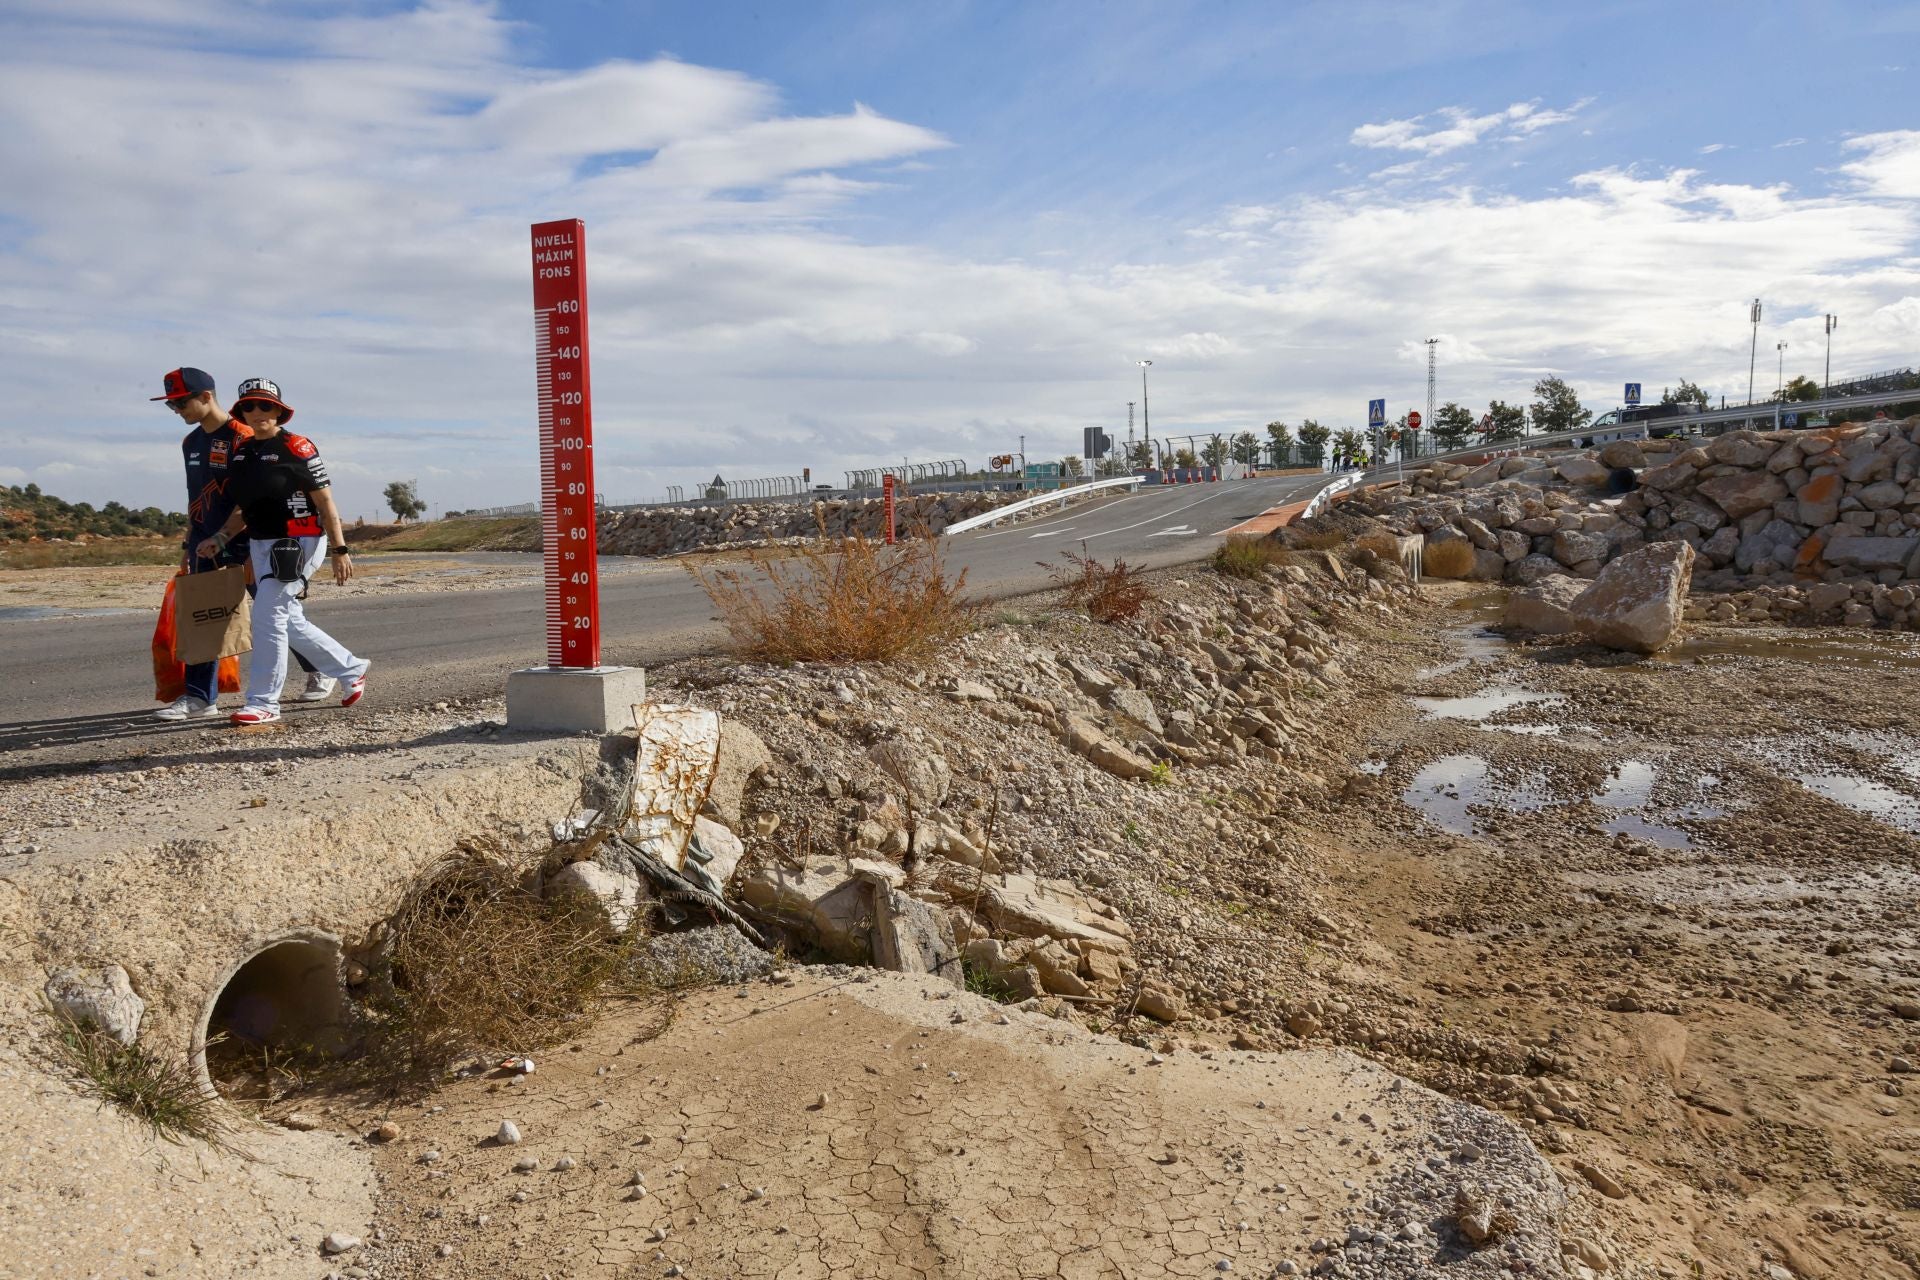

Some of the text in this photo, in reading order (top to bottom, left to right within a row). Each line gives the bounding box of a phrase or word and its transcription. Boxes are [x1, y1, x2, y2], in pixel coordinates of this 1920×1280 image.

[534, 233, 574, 247] NIVELL
[536, 249, 573, 264] MÁXIM
[539, 265, 571, 279] FONS
[556, 300, 578, 314] 160
[556, 326, 570, 335] 150
[557, 346, 580, 360] 140
[558, 372, 571, 381] 130
[239, 378, 278, 396] aprilia
[560, 391, 582, 405] 120
[559, 418, 571, 426] 110
[560, 437, 583, 451] 100
[561, 462, 572, 471] 90
[568, 482, 586, 495] 80
[563, 507, 573, 516] 70
[570, 527, 587, 540] 60
[564, 552, 575, 560] 50
[571, 571, 589, 585] 40
[566, 596, 577, 605] 30
[192, 604, 240, 623] SBK
[574, 616, 590, 629] 20
[567, 639, 576, 648] 10
